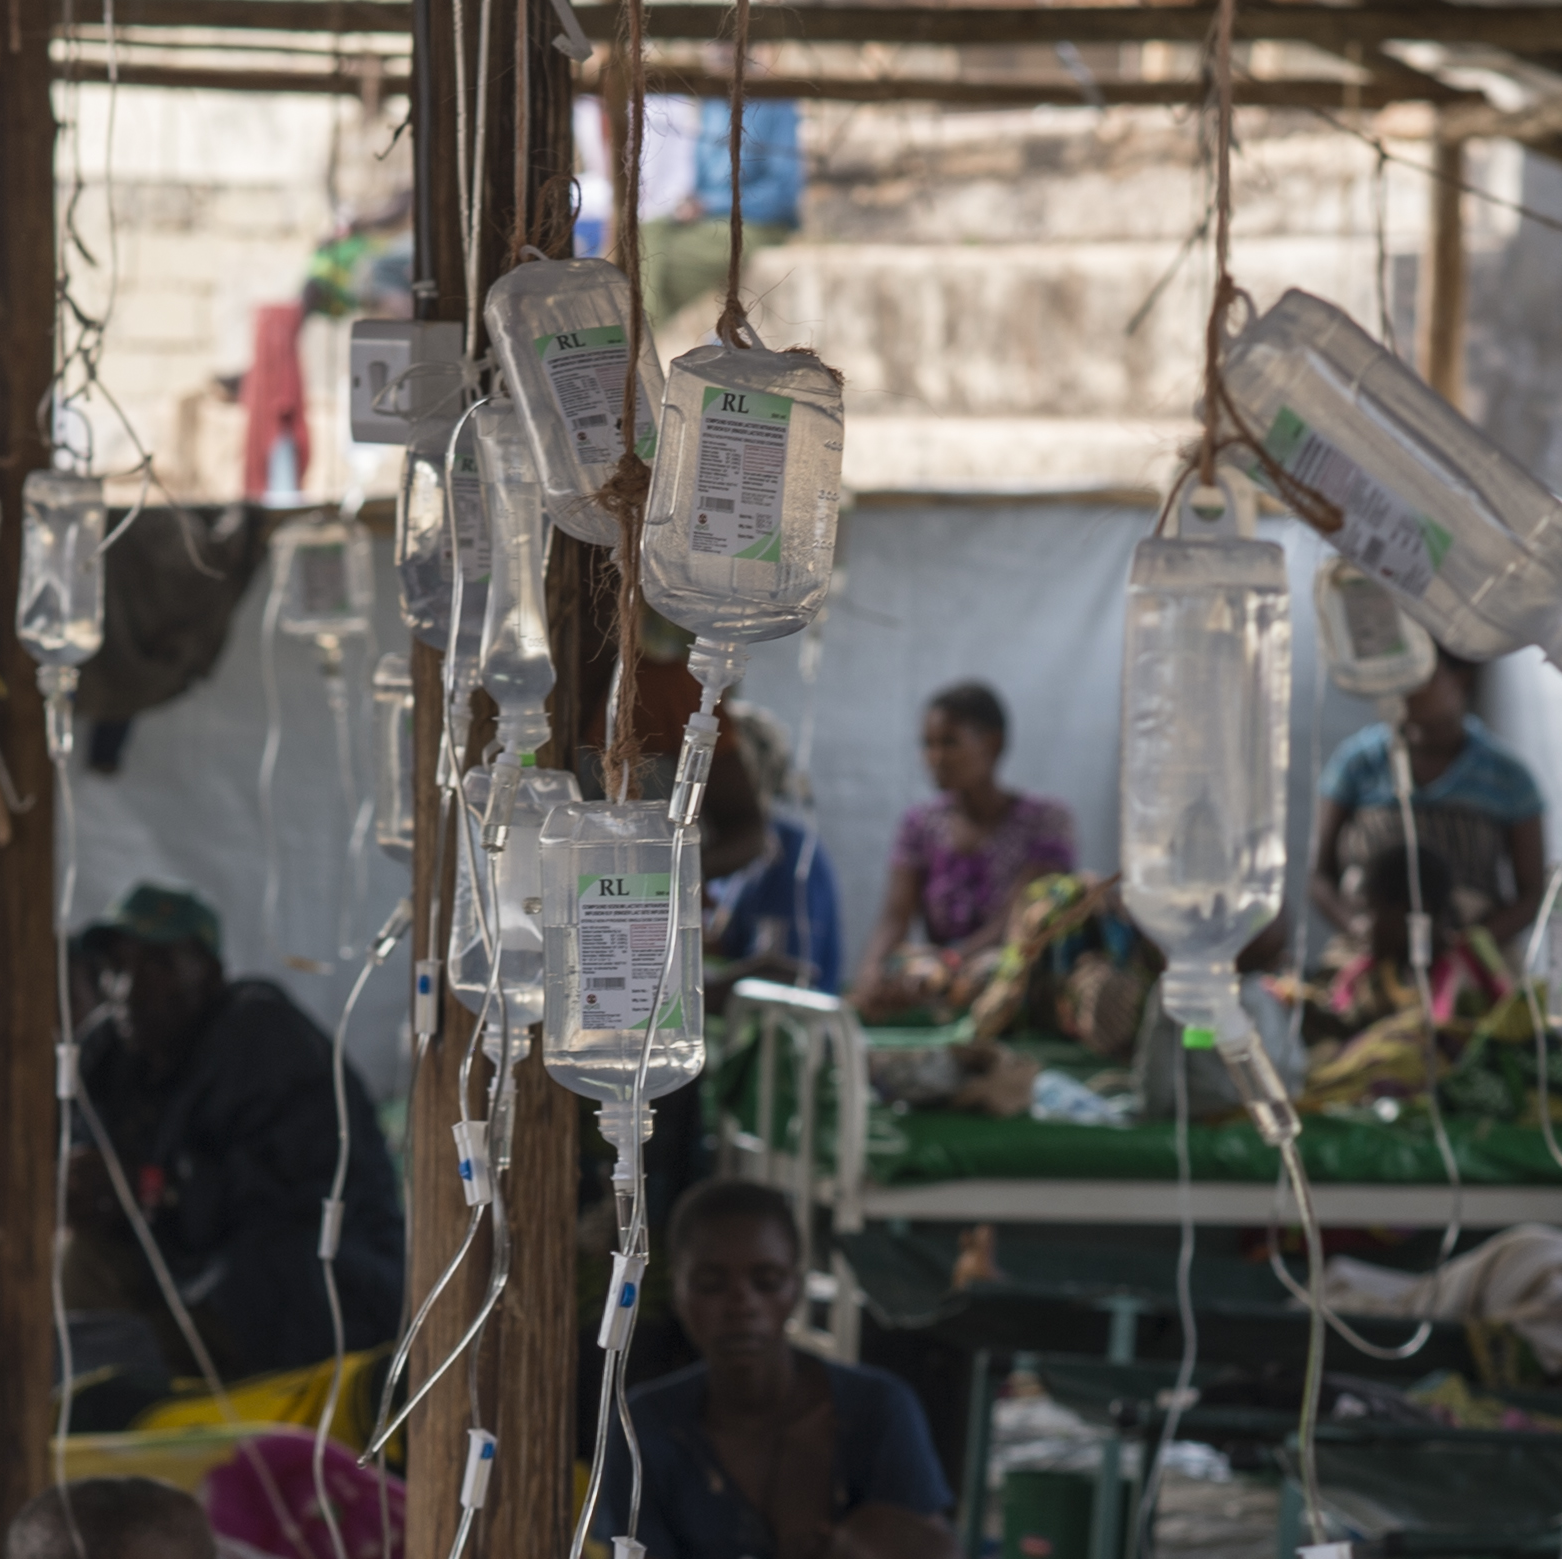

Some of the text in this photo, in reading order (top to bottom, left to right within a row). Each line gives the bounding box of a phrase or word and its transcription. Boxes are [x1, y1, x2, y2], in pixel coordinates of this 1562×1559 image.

[555, 333, 586, 351] RL
[721, 392, 749, 414] RL
[599, 878, 630, 897] RL
